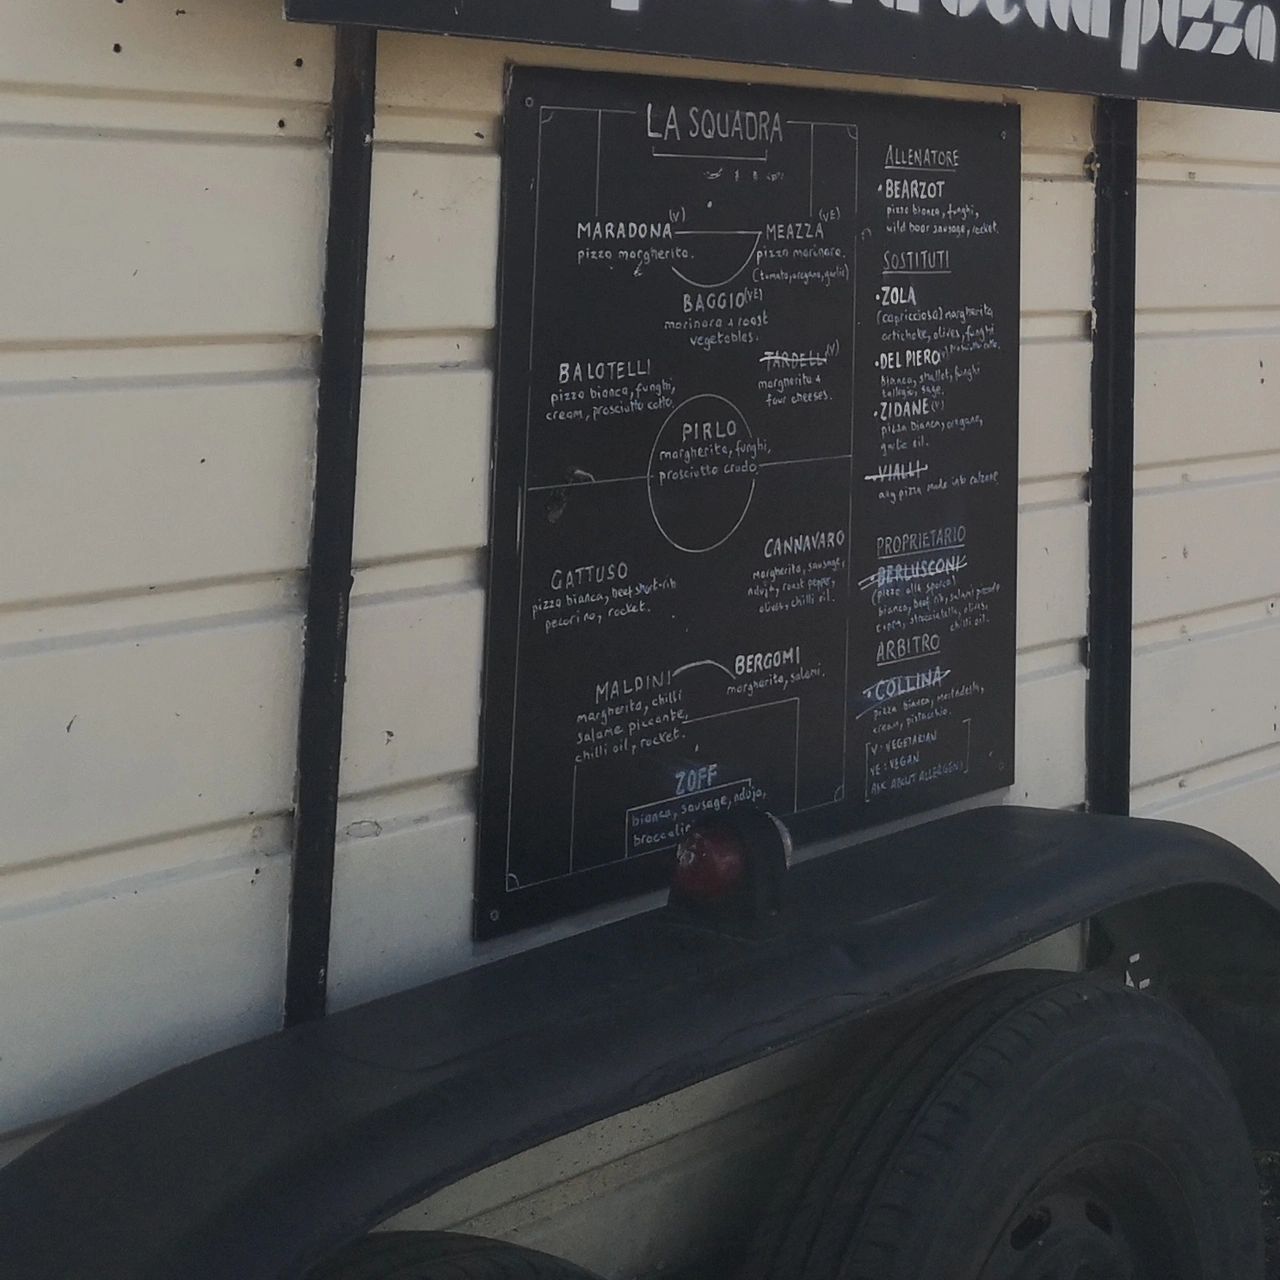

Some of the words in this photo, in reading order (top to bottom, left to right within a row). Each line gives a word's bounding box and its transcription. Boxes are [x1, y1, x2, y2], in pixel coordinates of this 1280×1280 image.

[647, 103, 681, 141] LA
[689, 106, 783, 143] SQUADRA
[885, 144, 960, 168] ALLENATORE
[885, 178, 946, 200] BEARZOT
[577, 222, 672, 241] MARADONA
[766, 222, 824, 241] MEAZZA
[886, 220, 907, 234] wild
[577, 248, 612, 264] pizza
[756, 245, 789, 265] pizza
[883, 250, 950, 270] SOSTITUTI
[683, 292, 745, 313] BAGGIO
[881, 286, 917, 306] ZOLA
[664, 318, 722, 330] marinara
[738, 310, 768, 327] roast
[880, 351, 902, 369] DEL
[906, 349, 941, 367] PIERO
[558, 358, 651, 384] BALOTELLI
[550, 390, 585, 407] pizza
[766, 393, 786, 407] four
[880, 397, 930, 421] ZIDANE
[592, 399, 644, 421] prosciutto
[682, 420, 737, 442] PIRLO
[658, 465, 718, 486] prosciutto
[764, 530, 845, 558] CANNAVARO
[876, 525, 966, 556] PROPRIETARIO
[550, 561, 628, 590] GATTUSO
[531, 598, 562, 620] pizza
[876, 633, 940, 662] ARBITRO
[734, 646, 802, 677] BERGOMI
[595, 670, 671, 704] MALDINI
[651, 689, 682, 707] chilli
[885, 730, 937, 752] VEGETARIAN
[575, 742, 608, 763] chilli
[889, 750, 920, 770] VEGAN
[674, 763, 718, 795] ZOFF
